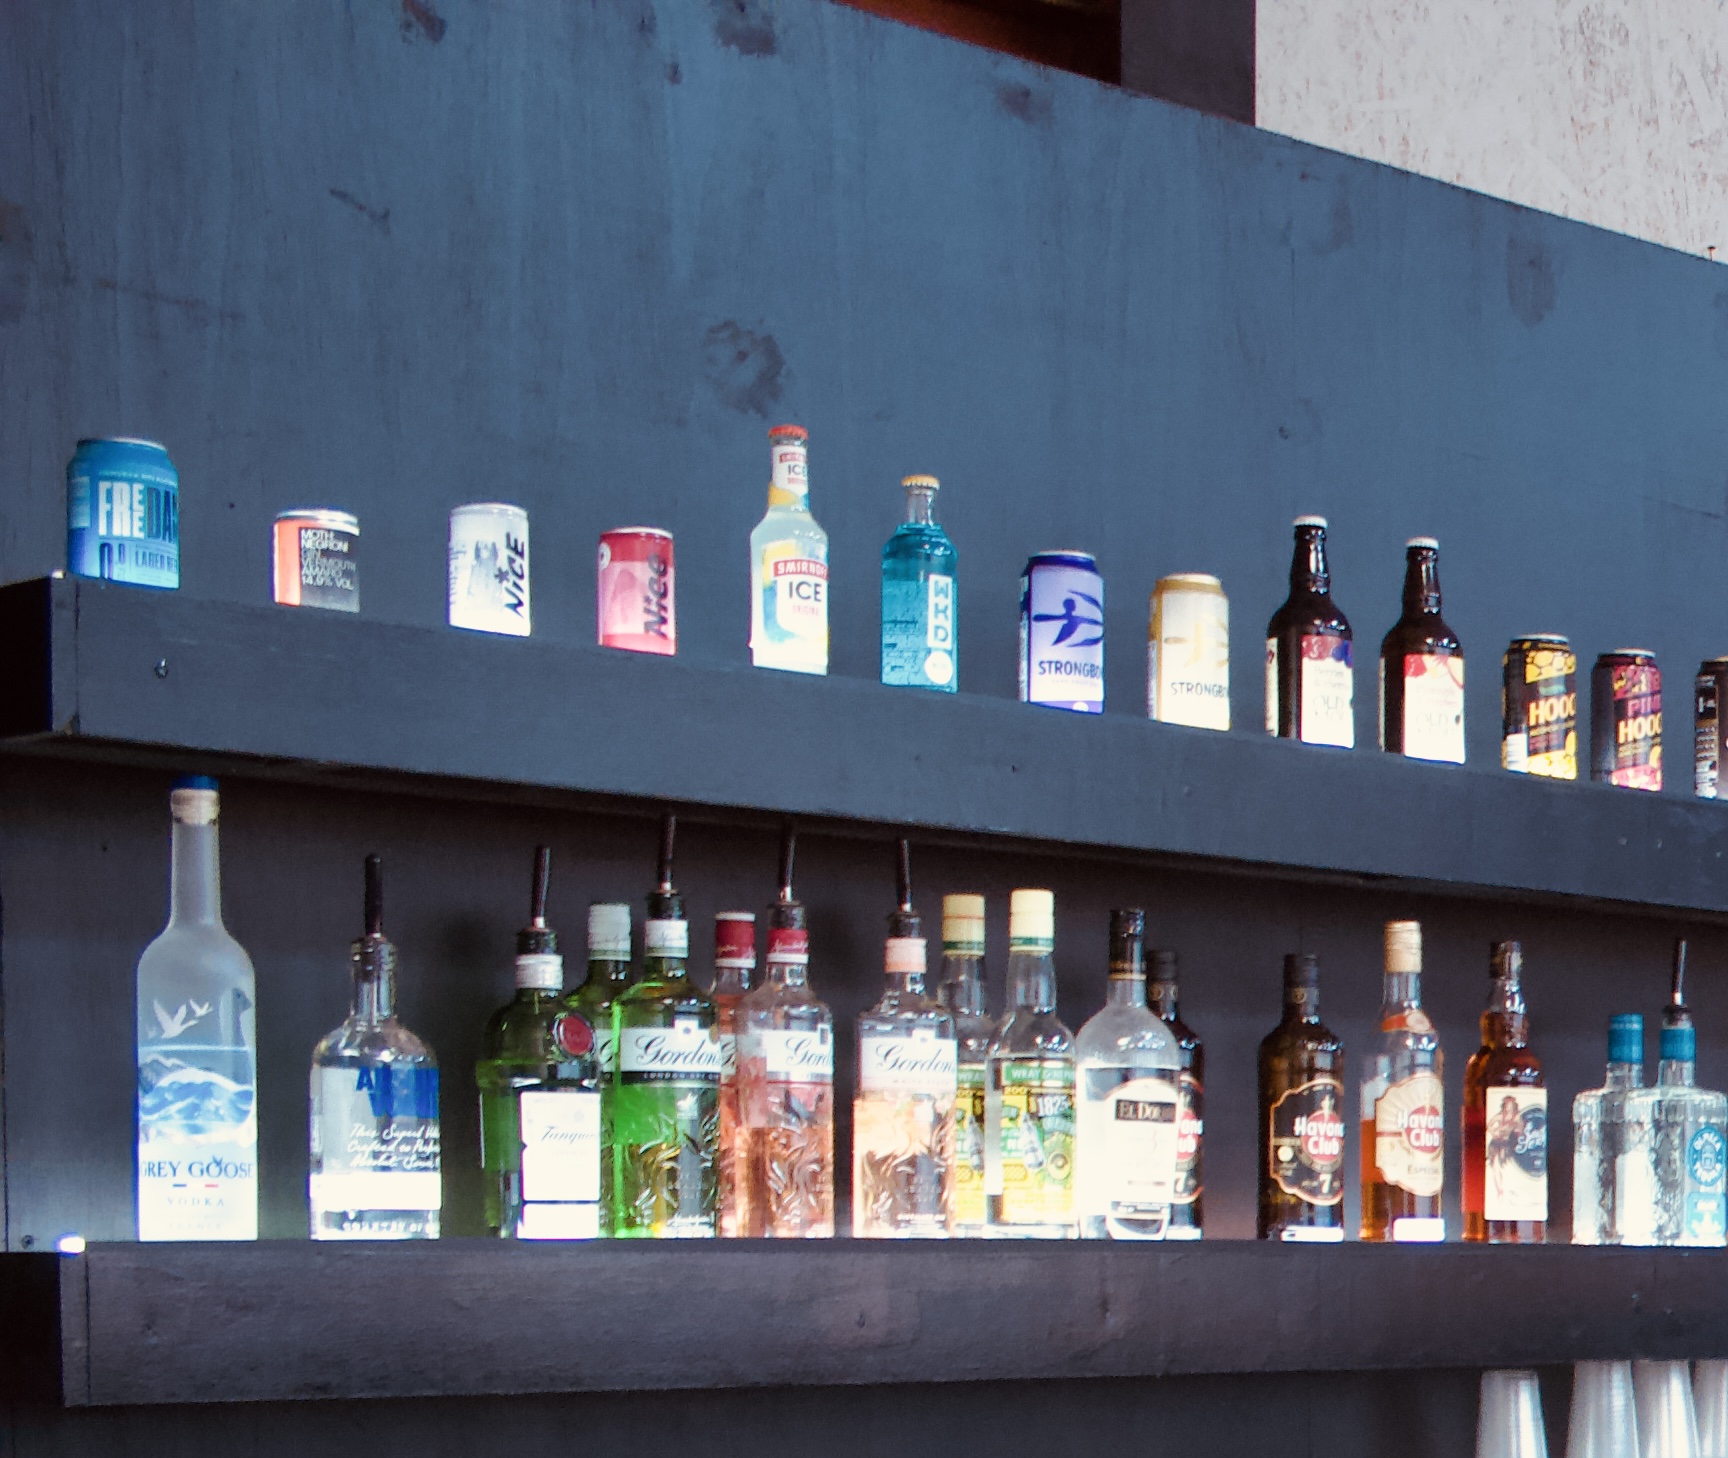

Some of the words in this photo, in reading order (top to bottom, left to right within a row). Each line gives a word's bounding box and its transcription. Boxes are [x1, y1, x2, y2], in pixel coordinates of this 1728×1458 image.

[301, 540, 349, 553] NEGRONI
[788, 581, 822, 602] ICE
[934, 580, 949, 642] WKD
[1307, 1134, 1340, 1155] Club
[1410, 1129, 1440, 1147] Club
[140, 1160, 181, 1178] GREY
[1319, 1173, 1333, 1194] 7
[168, 1197, 225, 1207] VODKA
